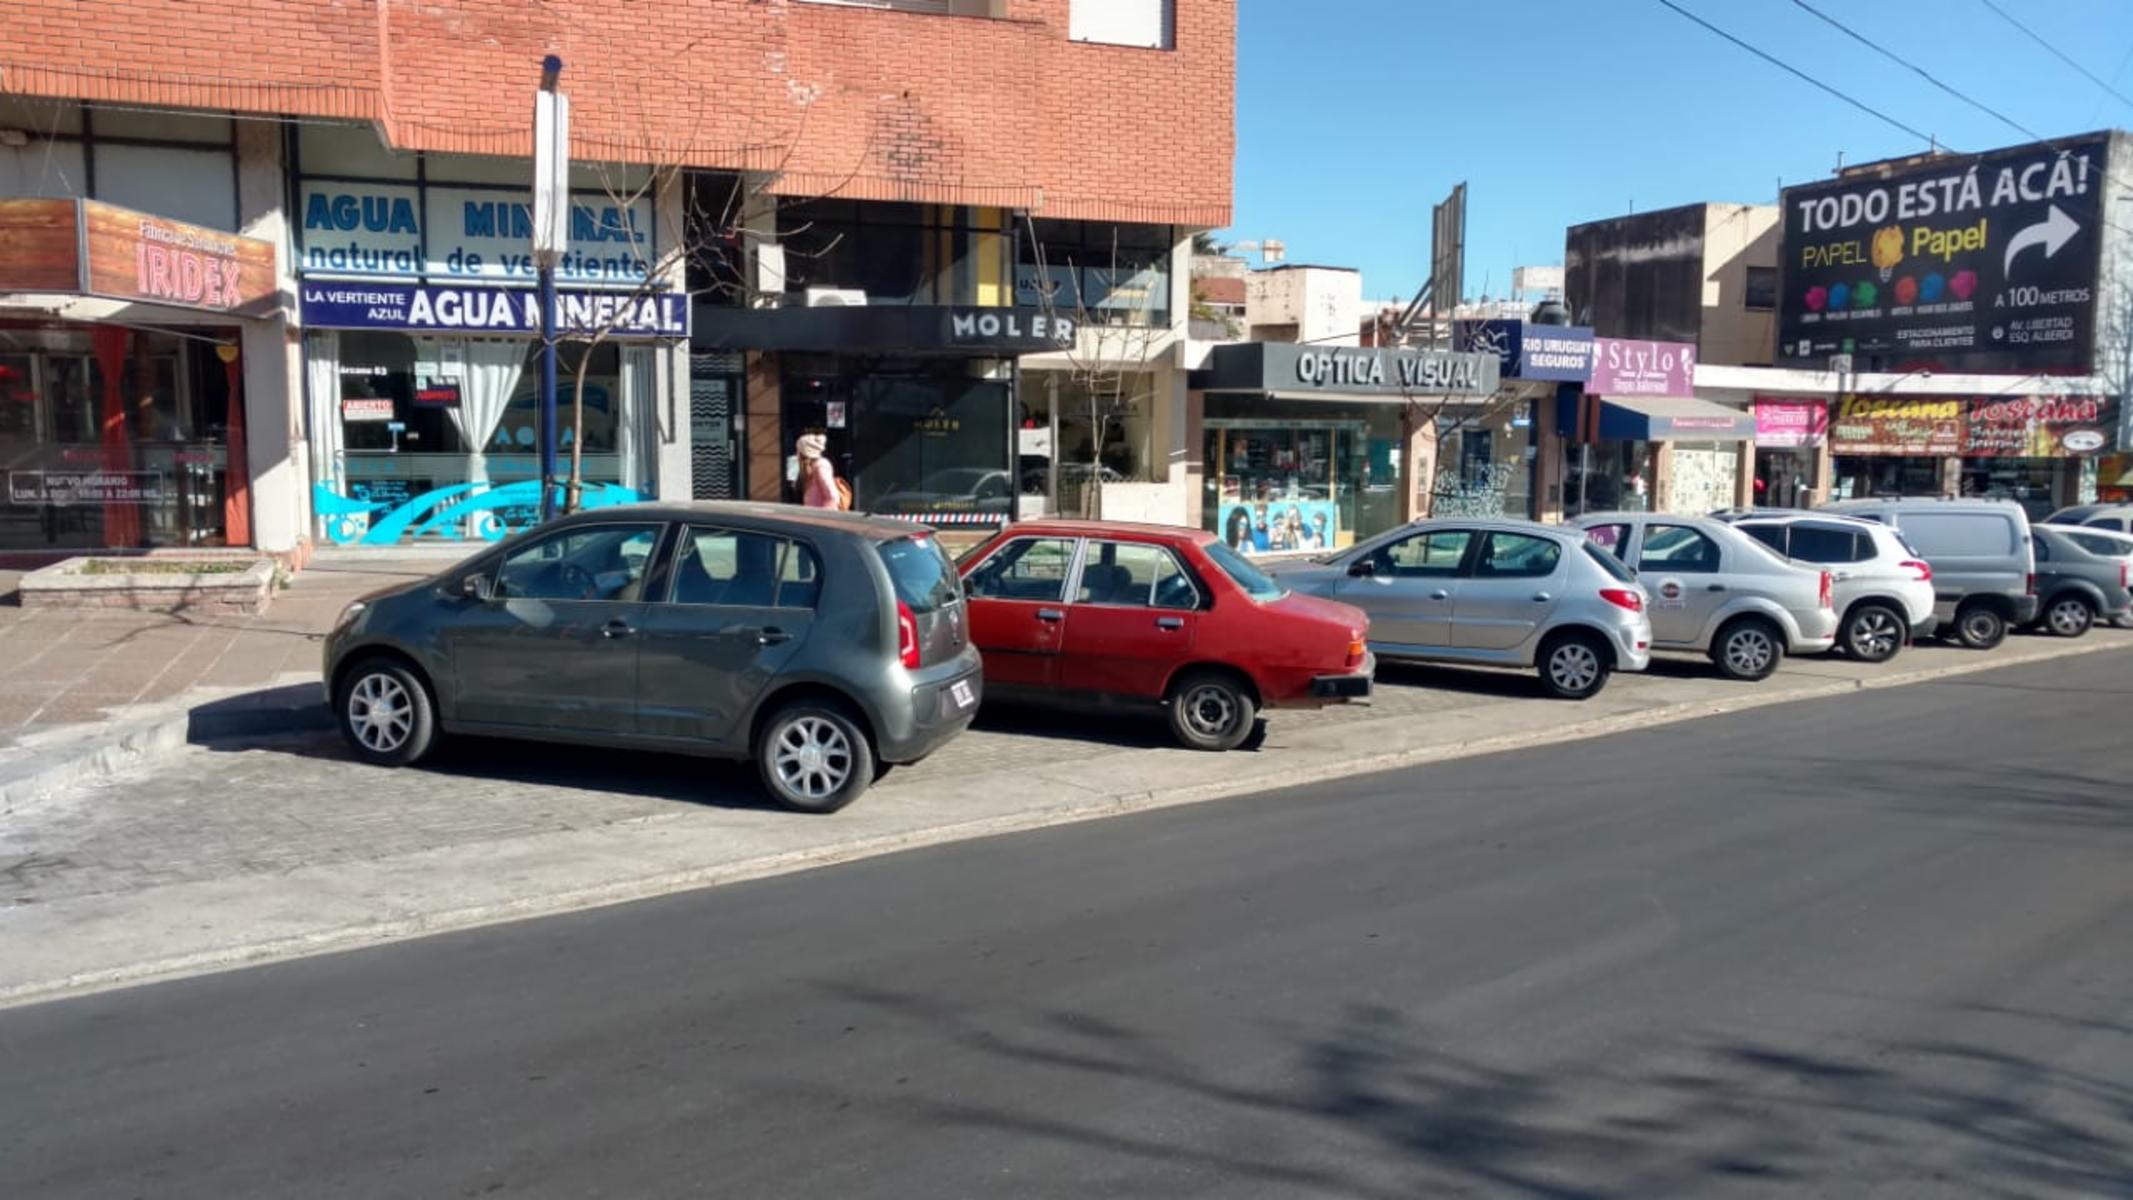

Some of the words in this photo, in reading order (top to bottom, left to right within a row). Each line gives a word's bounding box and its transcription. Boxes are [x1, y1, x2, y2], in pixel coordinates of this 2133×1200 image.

[1799, 188, 1889, 233] TODO
[1897, 165, 1982, 220] ESTÁ
[1990, 150, 2090, 206] ACÁ!
[305, 193, 418, 234] AGUA
[464, 201, 645, 243] MINRAL
[1802, 240, 1868, 268] PAPEL
[1911, 217, 1988, 264] Papel
[136, 241, 242, 308] IRIDEX
[308, 241, 426, 273] natural
[446, 247, 482, 271] de
[500, 249, 648, 280] vetiente
[305, 290, 326, 303] LA
[327, 291, 406, 306] VERTIENTE
[407, 289, 516, 328] AGUA
[524, 292, 683, 331] MINERAL
[1994, 293, 2005, 308] A
[2008, 286, 2039, 307] 100
[2040, 287, 2090, 305] METROS
[366, 308, 406, 321] AZUL
[953, 313, 1073, 342] MOLER
[1543, 338, 1592, 353] URUGUAY
[1608, 341, 1674, 378] Stylo
[1400, 356, 1478, 388] VISUAL
[1530, 353, 1585, 369] SEGUROS
[1840, 394, 1959, 419] Toscana
[1969, 396, 2098, 422] Toscana
